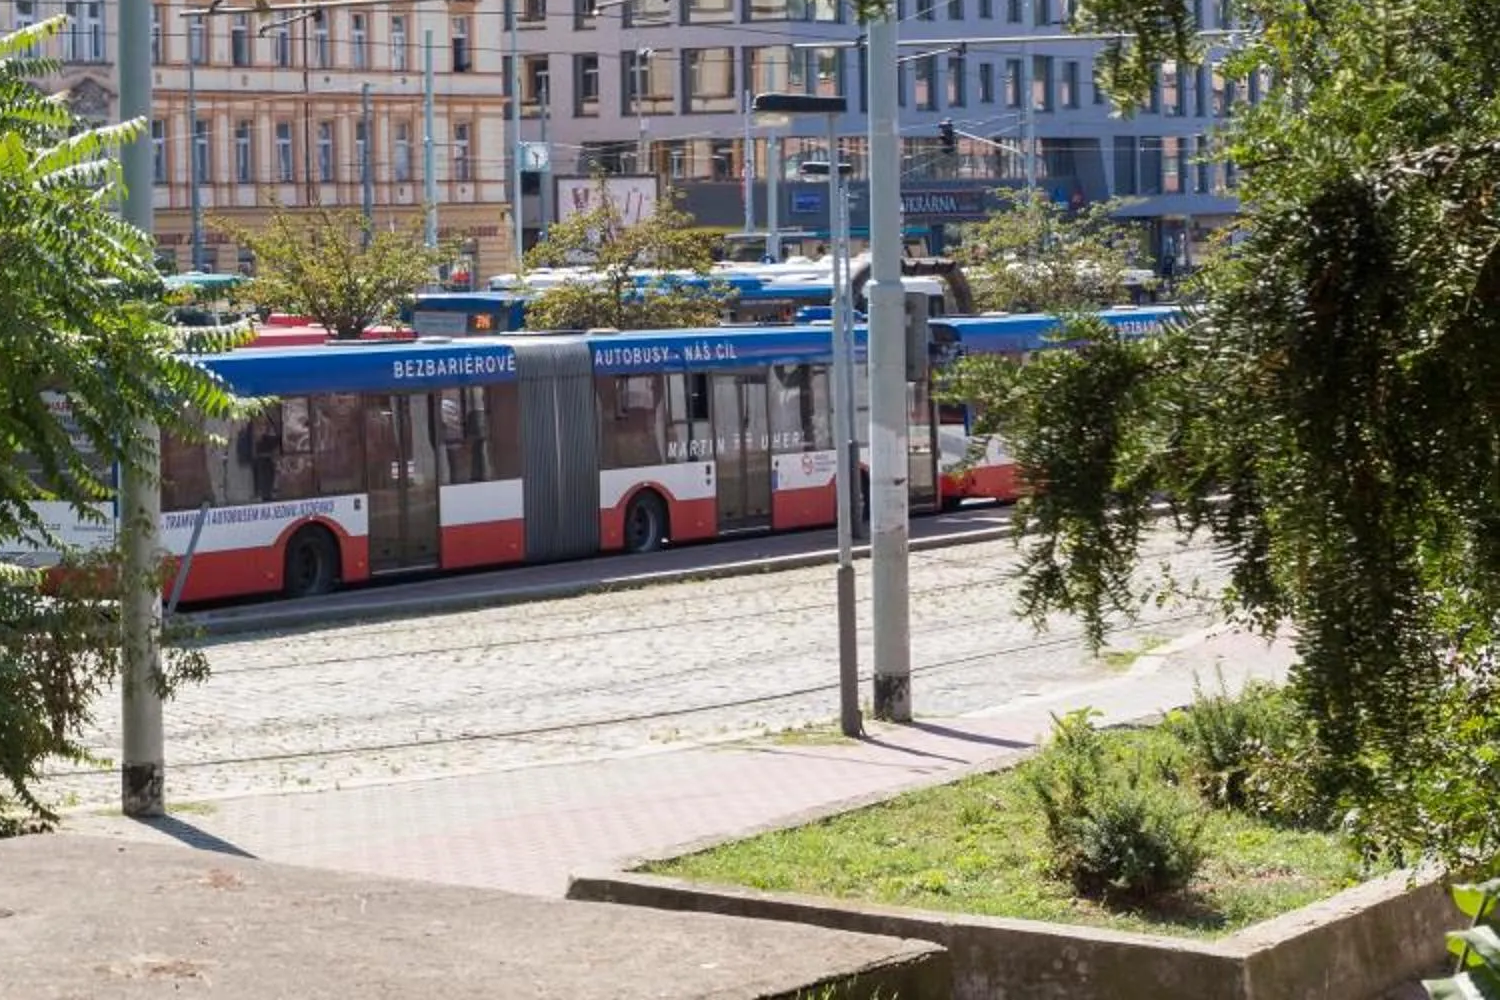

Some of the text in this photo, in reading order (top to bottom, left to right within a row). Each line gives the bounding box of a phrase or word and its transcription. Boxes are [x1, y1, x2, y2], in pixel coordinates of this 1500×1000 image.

[392, 352, 517, 380] BEZBARIÉROVÉ
[594, 346, 669, 367] AUTOBUSY
[716, 339, 738, 359] CÍL
[667, 434, 726, 458] MARTIN
